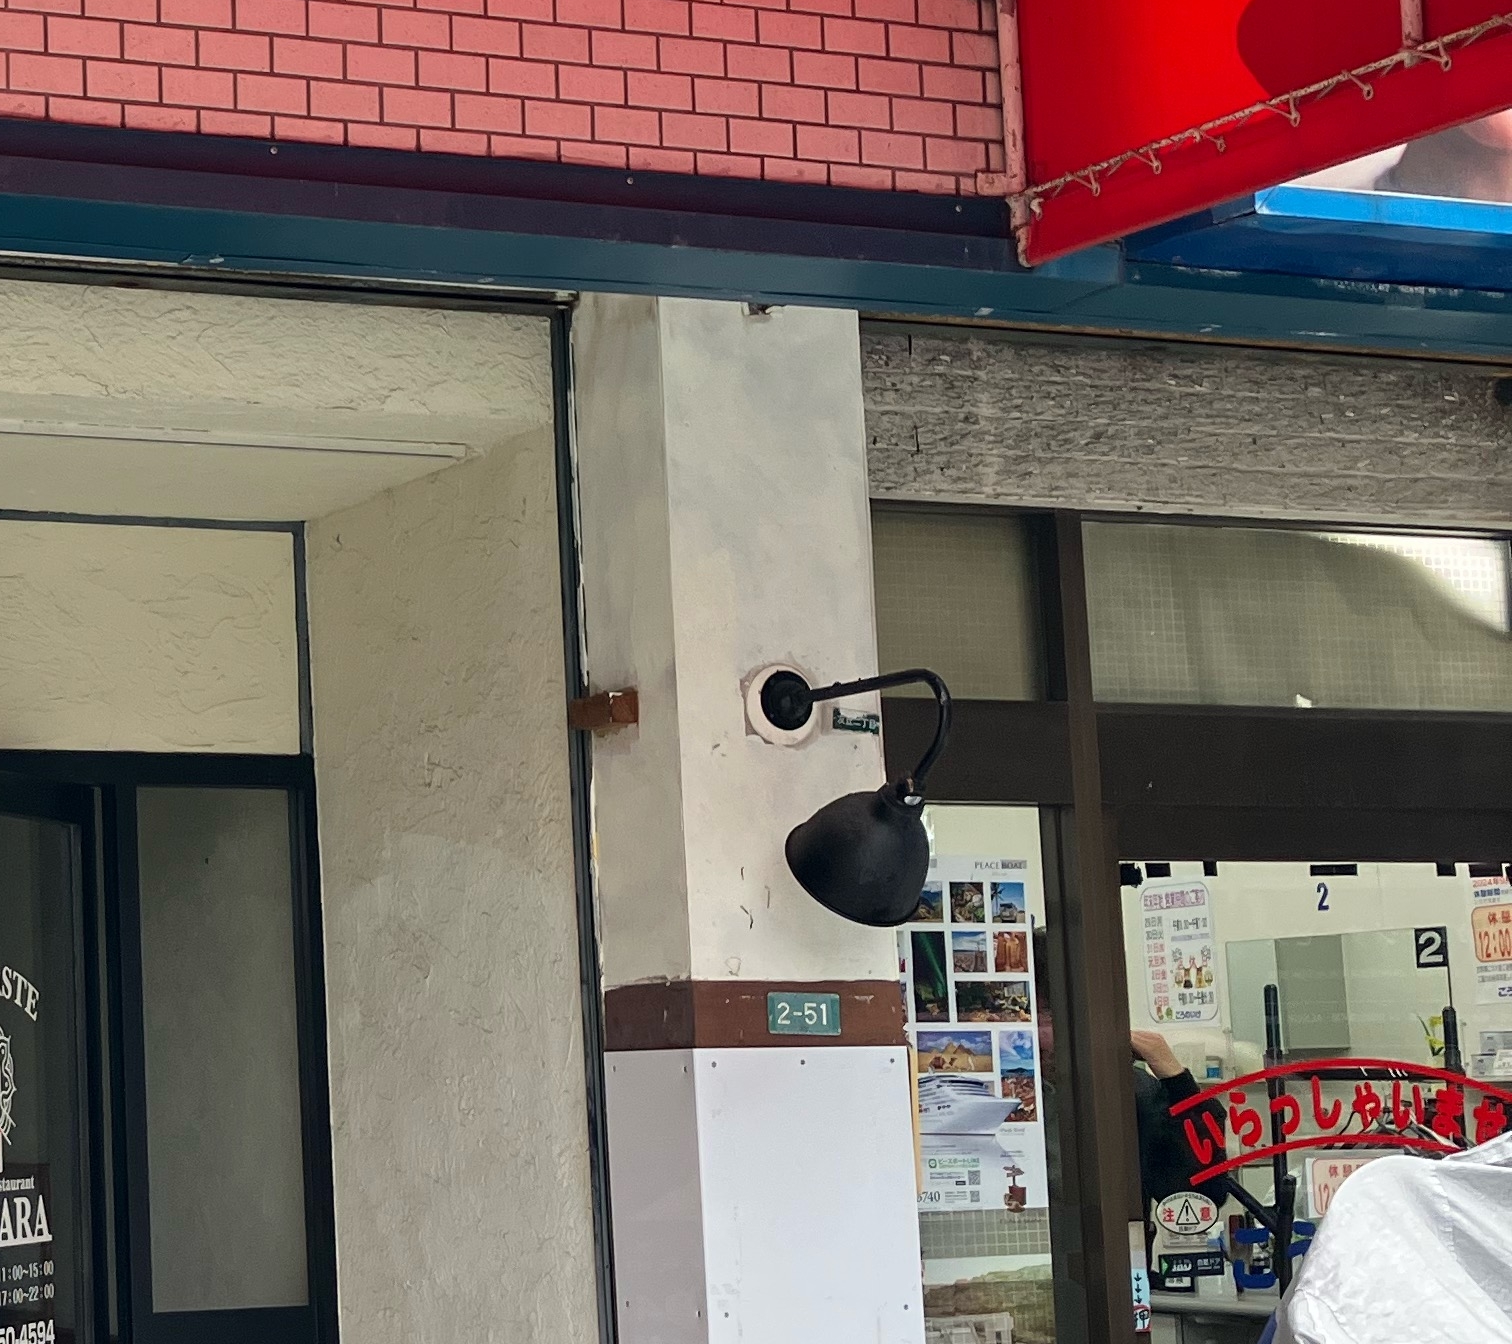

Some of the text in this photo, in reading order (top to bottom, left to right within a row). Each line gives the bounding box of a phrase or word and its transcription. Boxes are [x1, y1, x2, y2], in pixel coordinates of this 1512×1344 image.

[1316, 882, 1330, 912] 2
[1418, 930, 1444, 964] 2
[776, 1002, 828, 1026] 2-51
